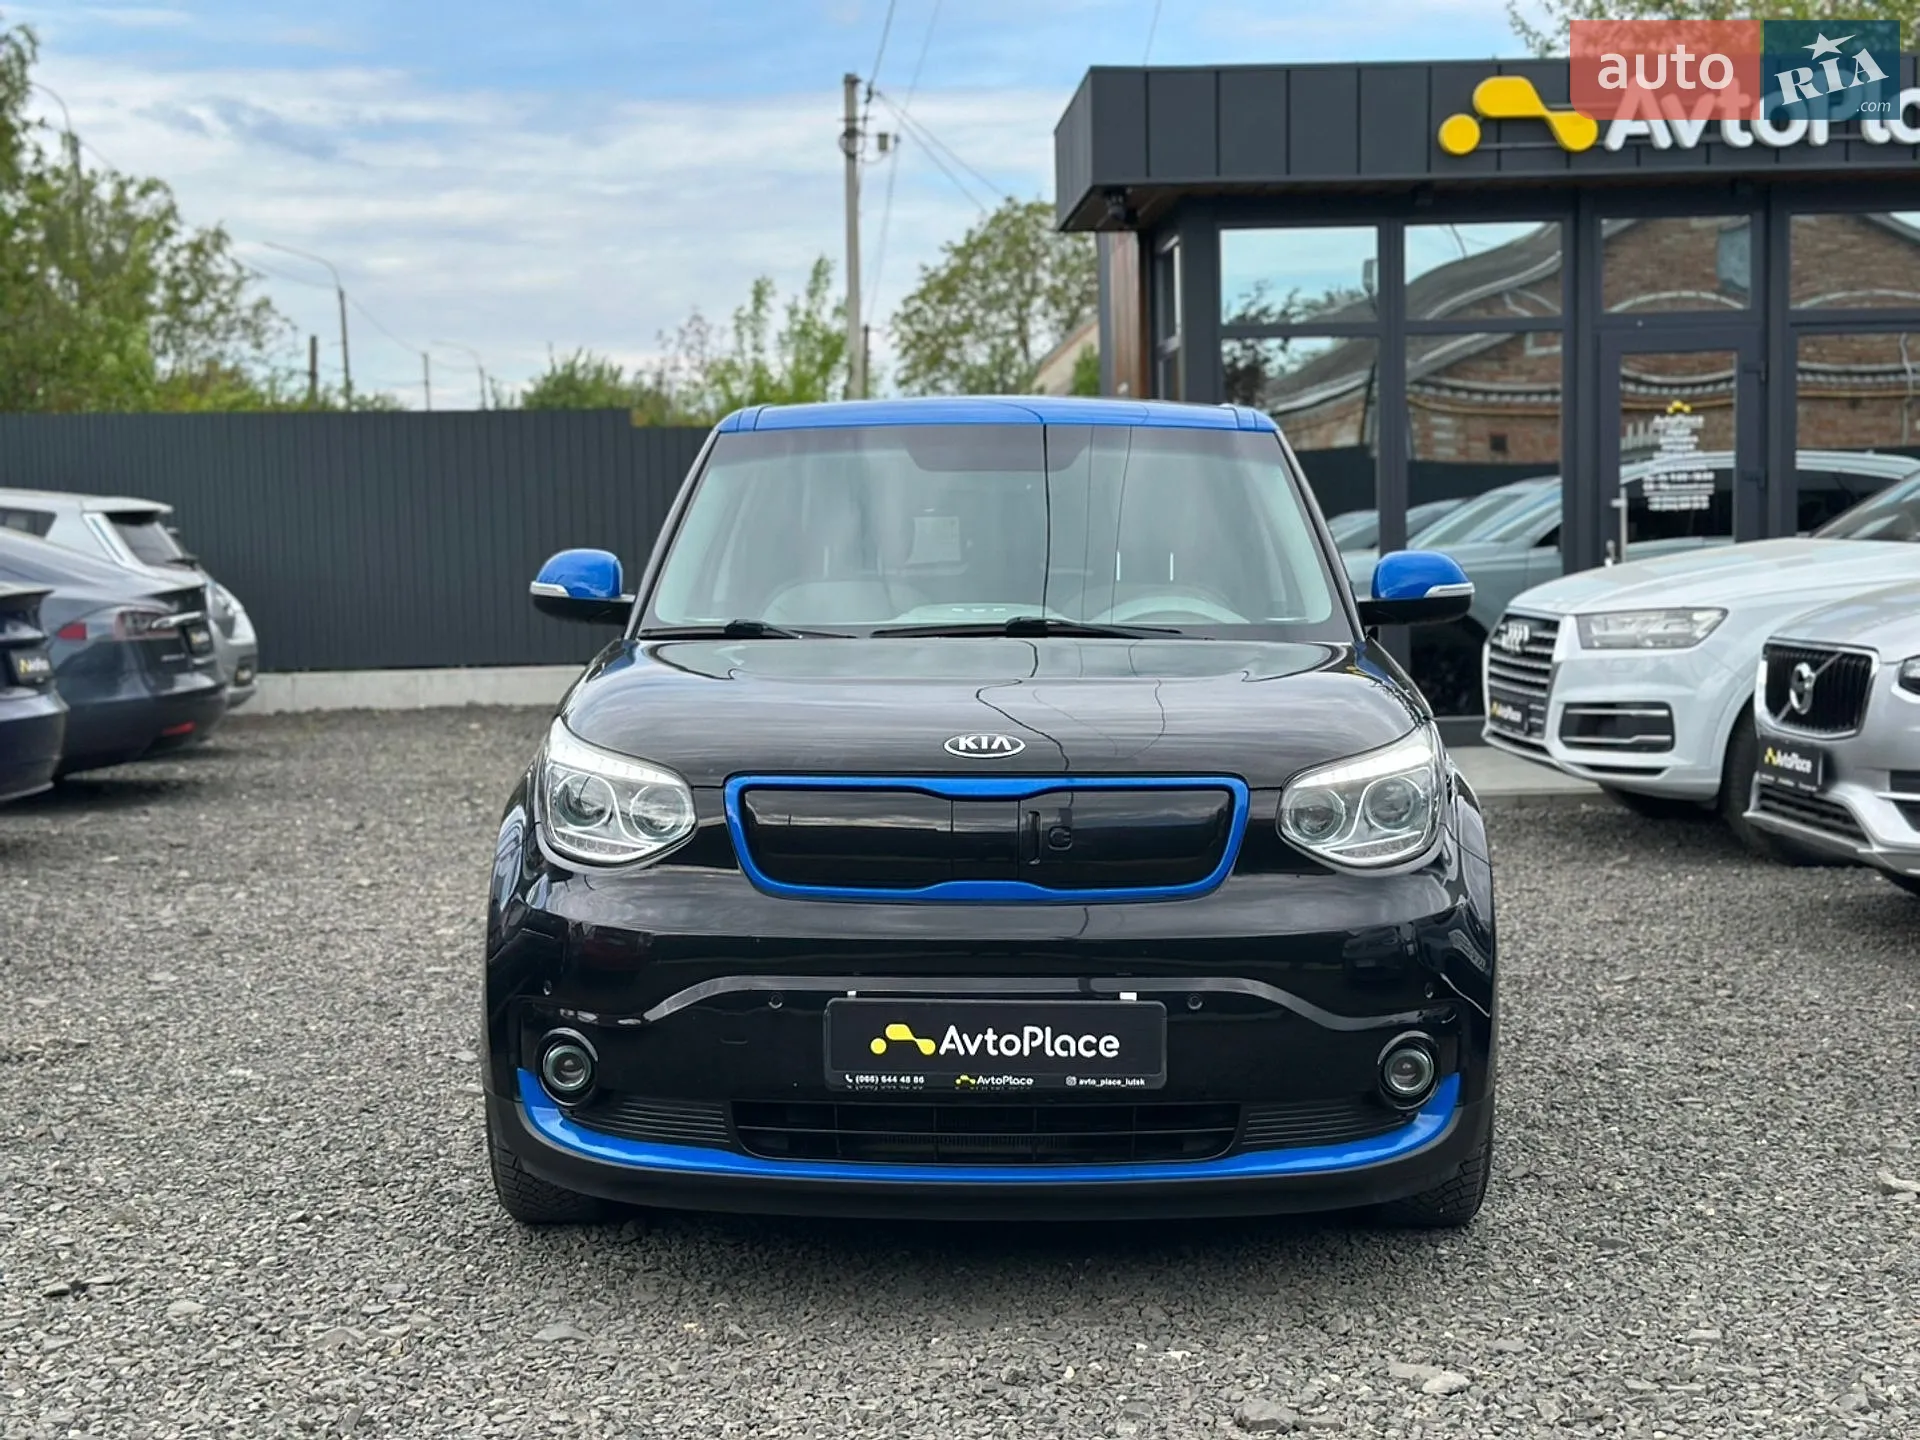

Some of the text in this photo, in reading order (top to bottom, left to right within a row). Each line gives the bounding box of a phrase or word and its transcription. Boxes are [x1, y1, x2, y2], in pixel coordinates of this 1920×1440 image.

[958, 735, 1012, 751] KIA
[938, 1025, 1120, 1058] AvtoPlace
[976, 1075, 1034, 1085] AvtoPlace
